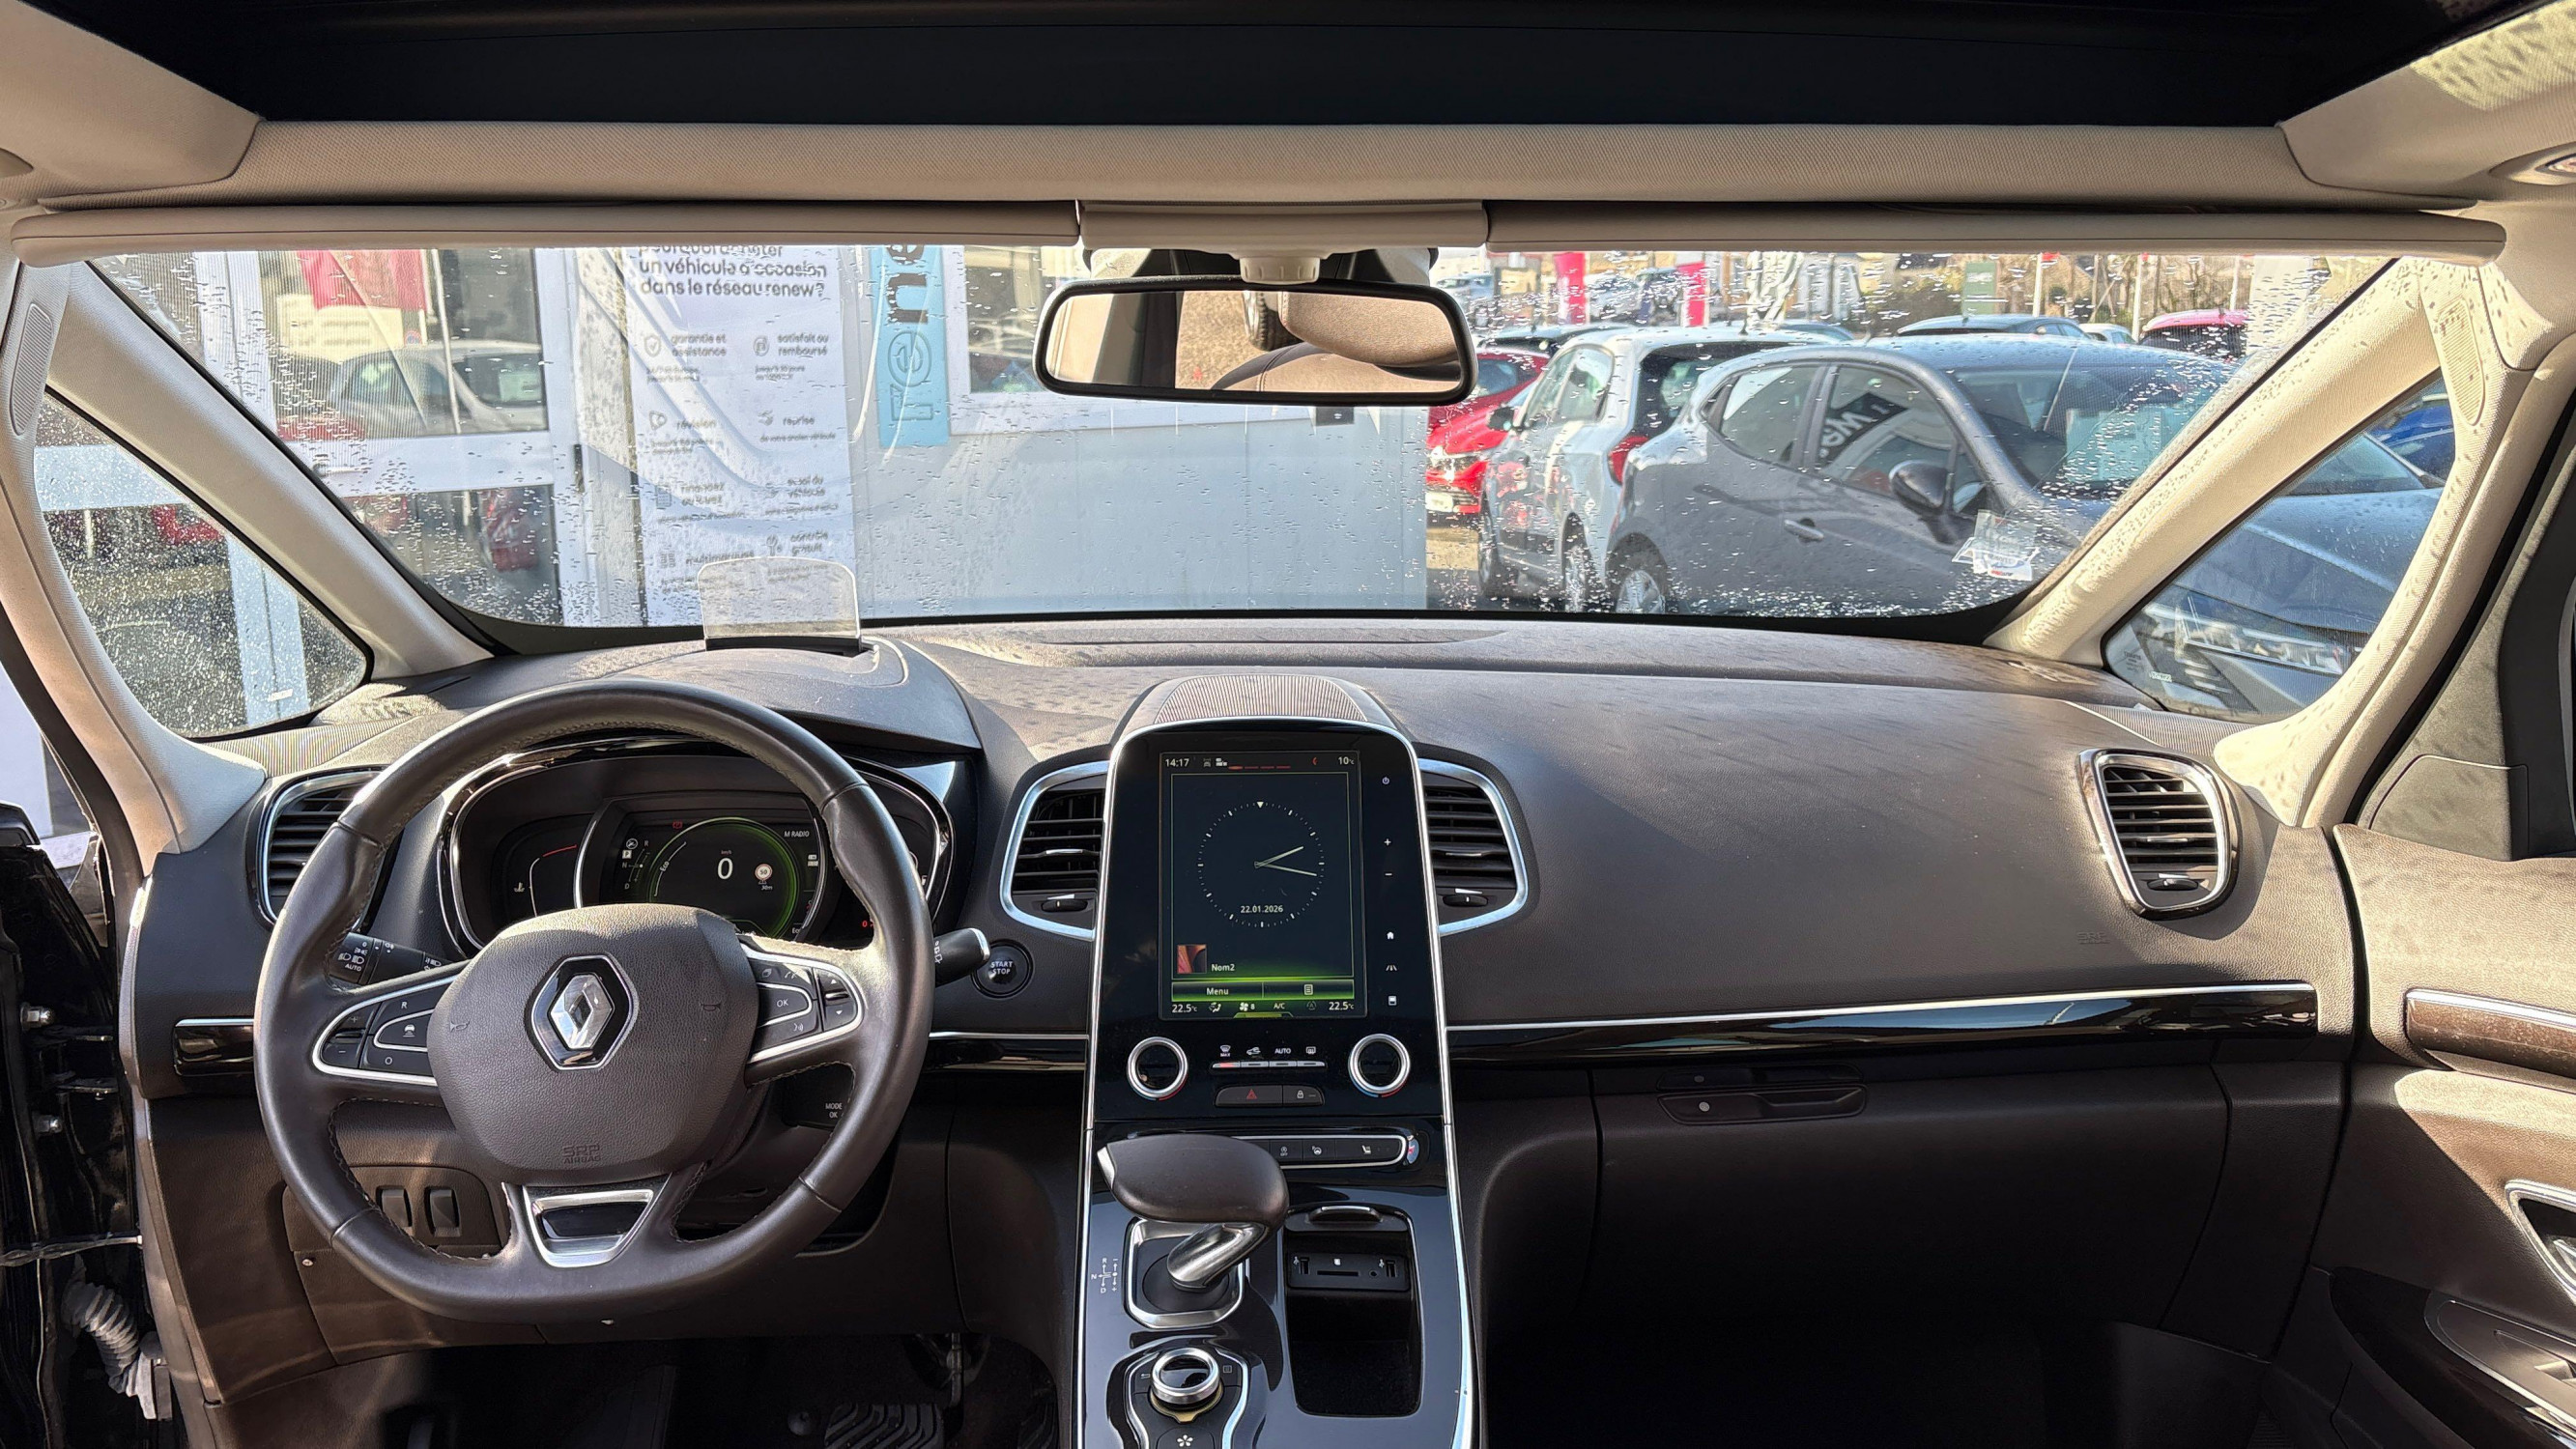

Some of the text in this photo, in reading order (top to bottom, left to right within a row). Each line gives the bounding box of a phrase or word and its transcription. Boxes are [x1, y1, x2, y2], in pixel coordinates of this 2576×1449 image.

[639, 259, 661, 273] un
[664, 257, 737, 275] véhicule
[641, 277, 685, 296] dans
[688, 278, 704, 296] le
[705, 278, 763, 296] réseau
[778, 345, 828, 356] remboursé
[783, 415, 816, 427] reprise
[1164, 757, 1189, 768] 14:17
[717, 858, 733, 880] 0
[1240, 905, 1284, 914] 22.01.2026
[344, 963, 362, 972] AUTO
[1211, 963, 1235, 972] Nom2
[1206, 987, 1229, 996] Menu
[401, 1001, 408, 1009] R
[776, 999, 789, 1008] OK
[562, 1144, 600, 1157] SRP
[563, 1155, 601, 1164] AIRBAG
